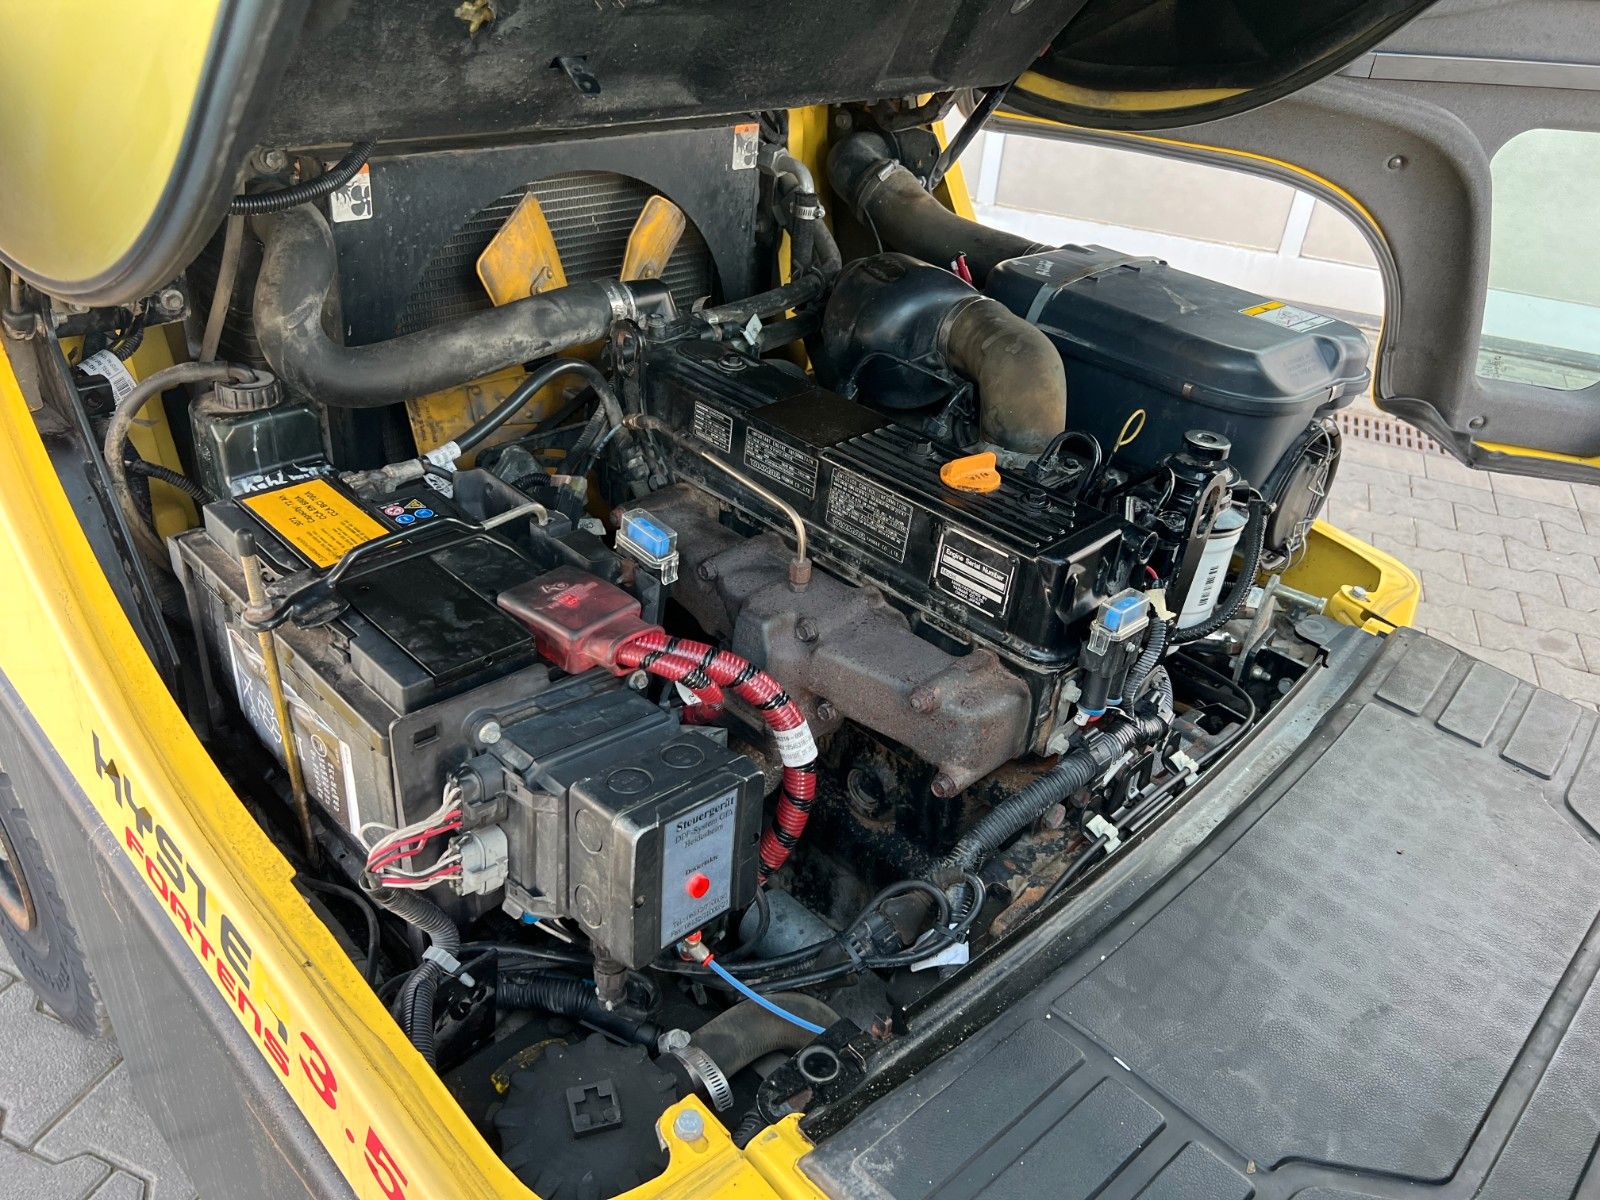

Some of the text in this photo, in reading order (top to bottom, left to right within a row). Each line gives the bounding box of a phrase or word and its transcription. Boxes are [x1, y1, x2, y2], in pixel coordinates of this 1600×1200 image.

[945, 548, 1004, 581] Engine Serial Number
[676, 797, 734, 832] Steuergerät
[91, 729, 288, 1045] HYSTE
[299, 1031, 409, 1200] 3.5
